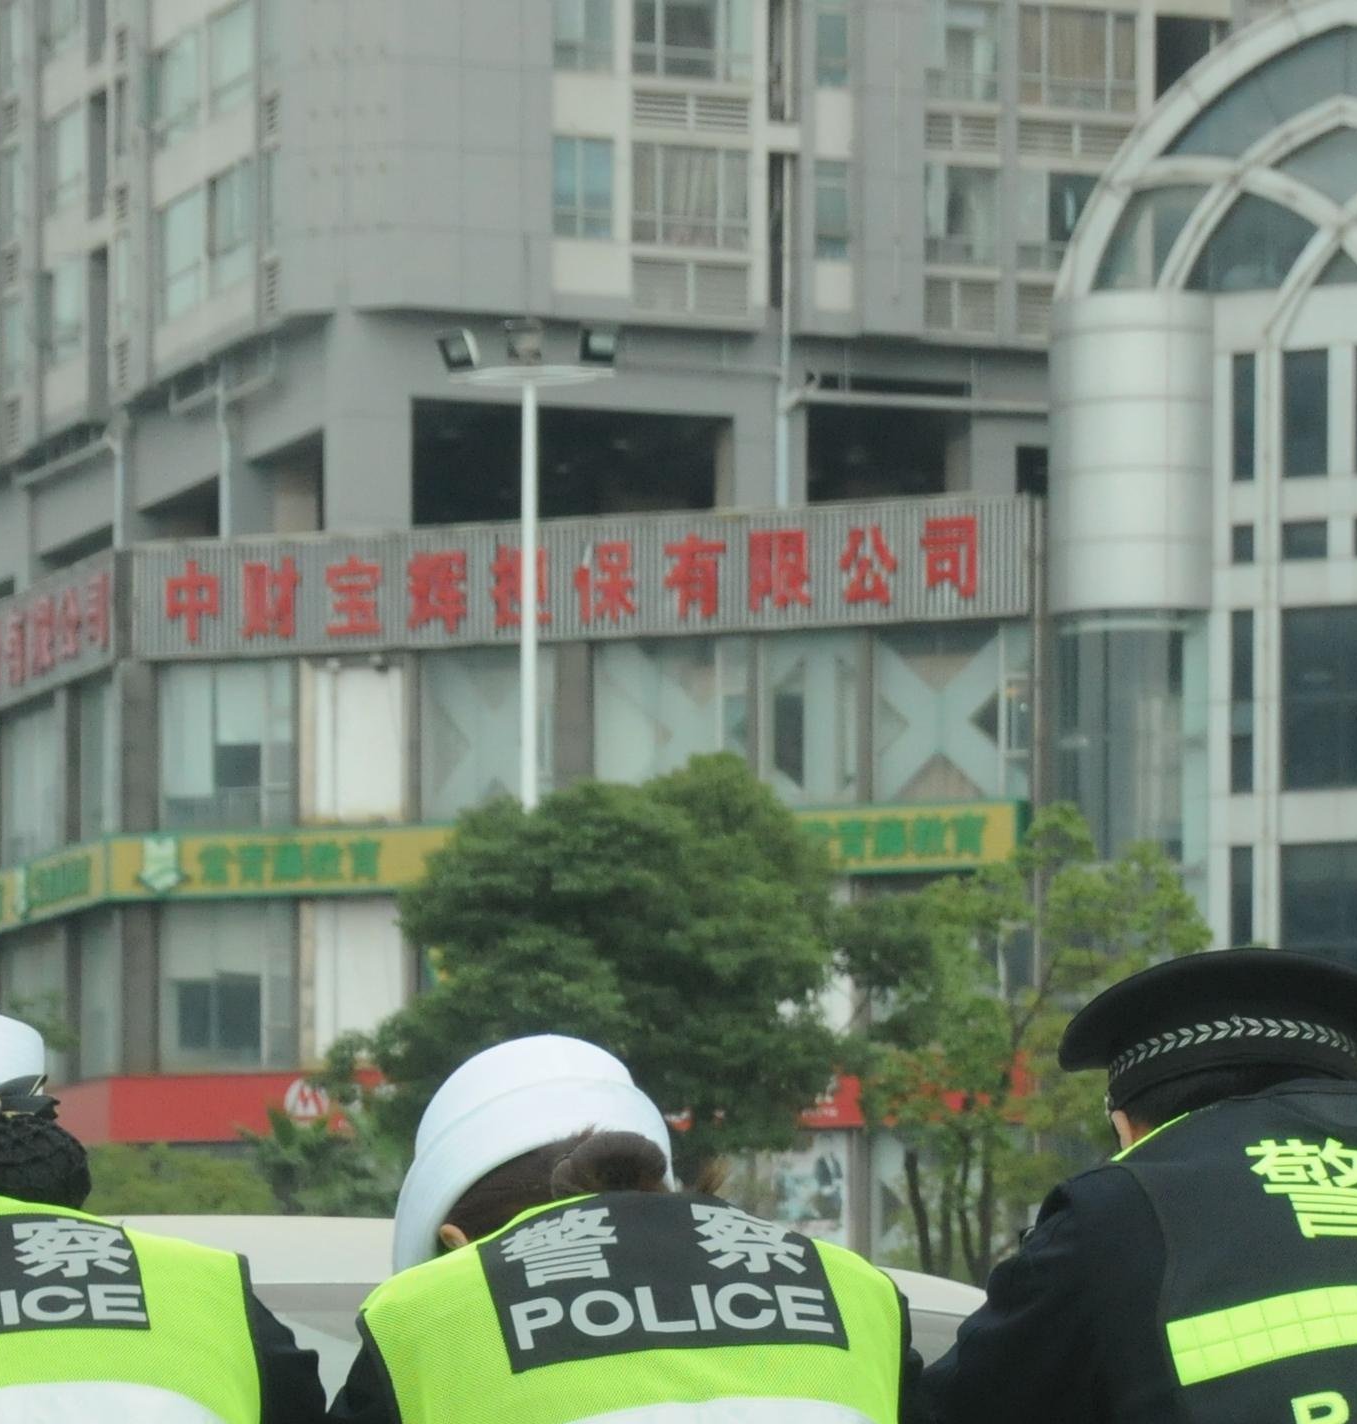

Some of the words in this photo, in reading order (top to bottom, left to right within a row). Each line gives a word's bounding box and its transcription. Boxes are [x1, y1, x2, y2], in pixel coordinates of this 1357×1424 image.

[165, 514, 980, 645] 中财宝辉担保有限公司
[500, 1202, 807, 1288] 警察
[509, 1282, 834, 1350] POLICE
